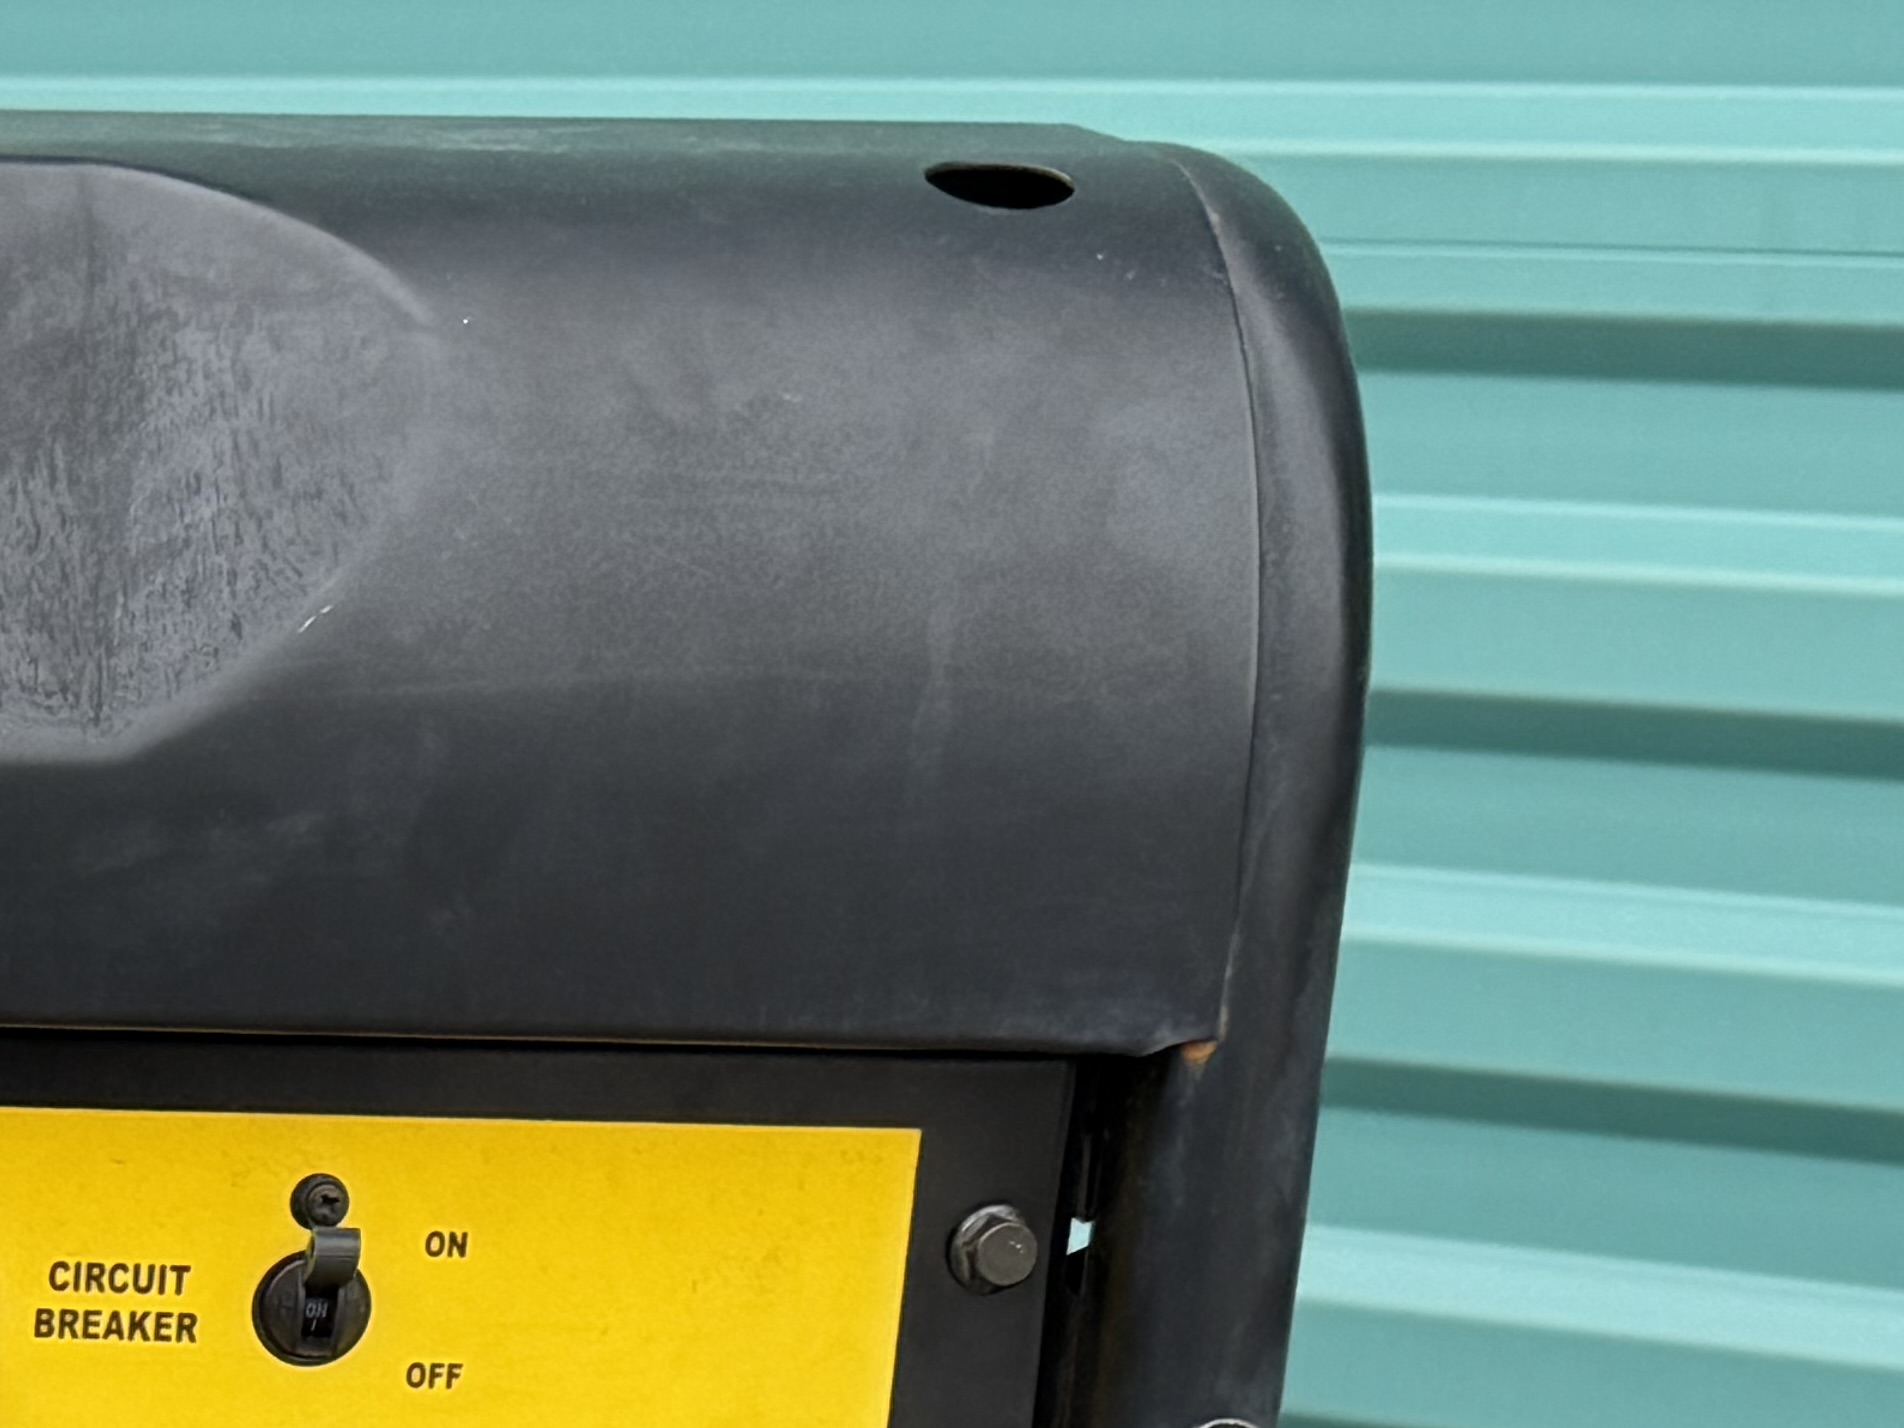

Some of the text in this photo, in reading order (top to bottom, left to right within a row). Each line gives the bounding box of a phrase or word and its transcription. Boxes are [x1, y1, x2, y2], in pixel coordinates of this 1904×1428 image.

[425, 1231, 468, 1259] ON
[48, 1260, 191, 1296] CIRCUIT
[34, 1307, 198, 1343] BREAKER
[406, 1362, 463, 1390] OFF
